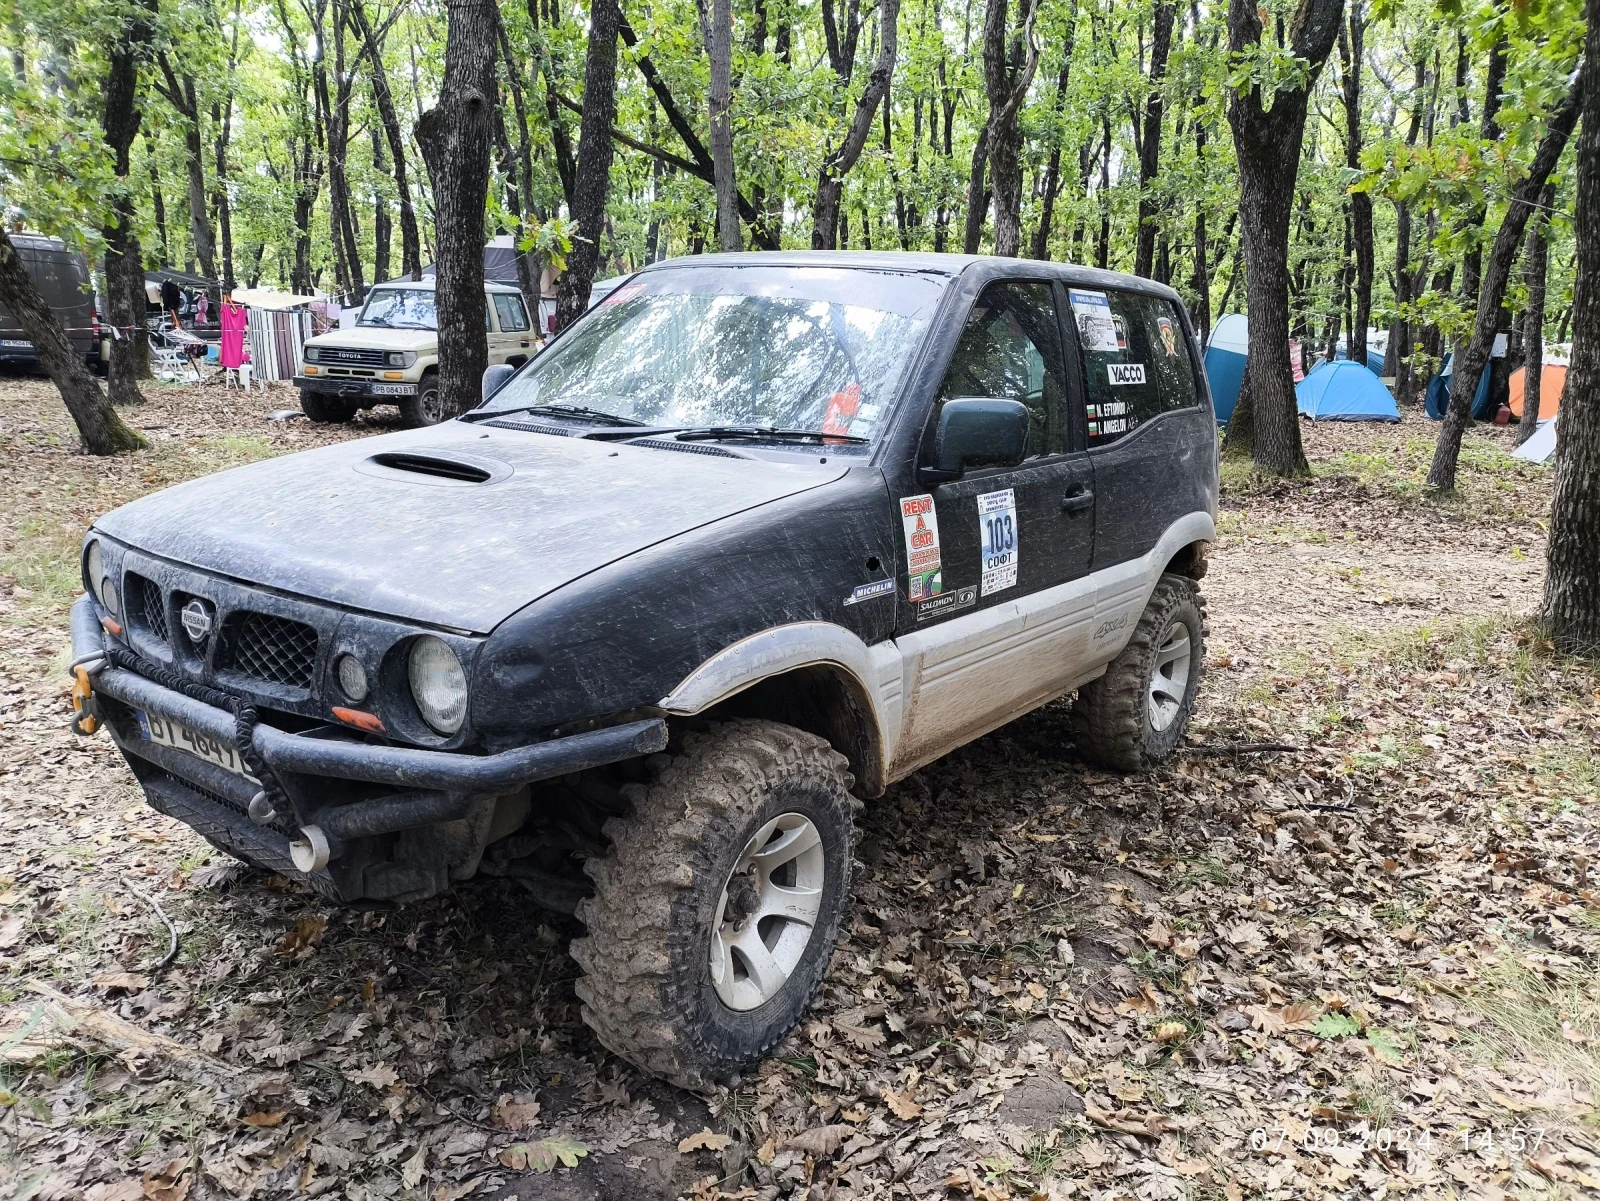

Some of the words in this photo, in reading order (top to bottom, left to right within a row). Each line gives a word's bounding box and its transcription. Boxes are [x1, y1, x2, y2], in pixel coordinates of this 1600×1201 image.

[1111, 365, 1142, 383] YACCO
[1103, 418, 1127, 434] ANGELOV
[903, 498, 932, 517] RENT
[916, 514, 926, 531] A
[910, 530, 934, 550] CAR
[986, 514, 1014, 555] 103
[987, 551, 1013, 570] СОФТ
[856, 581, 893, 598] MICHELIN
[920, 595, 954, 611] SALOMON
[183, 612, 206, 628] NISSAN
